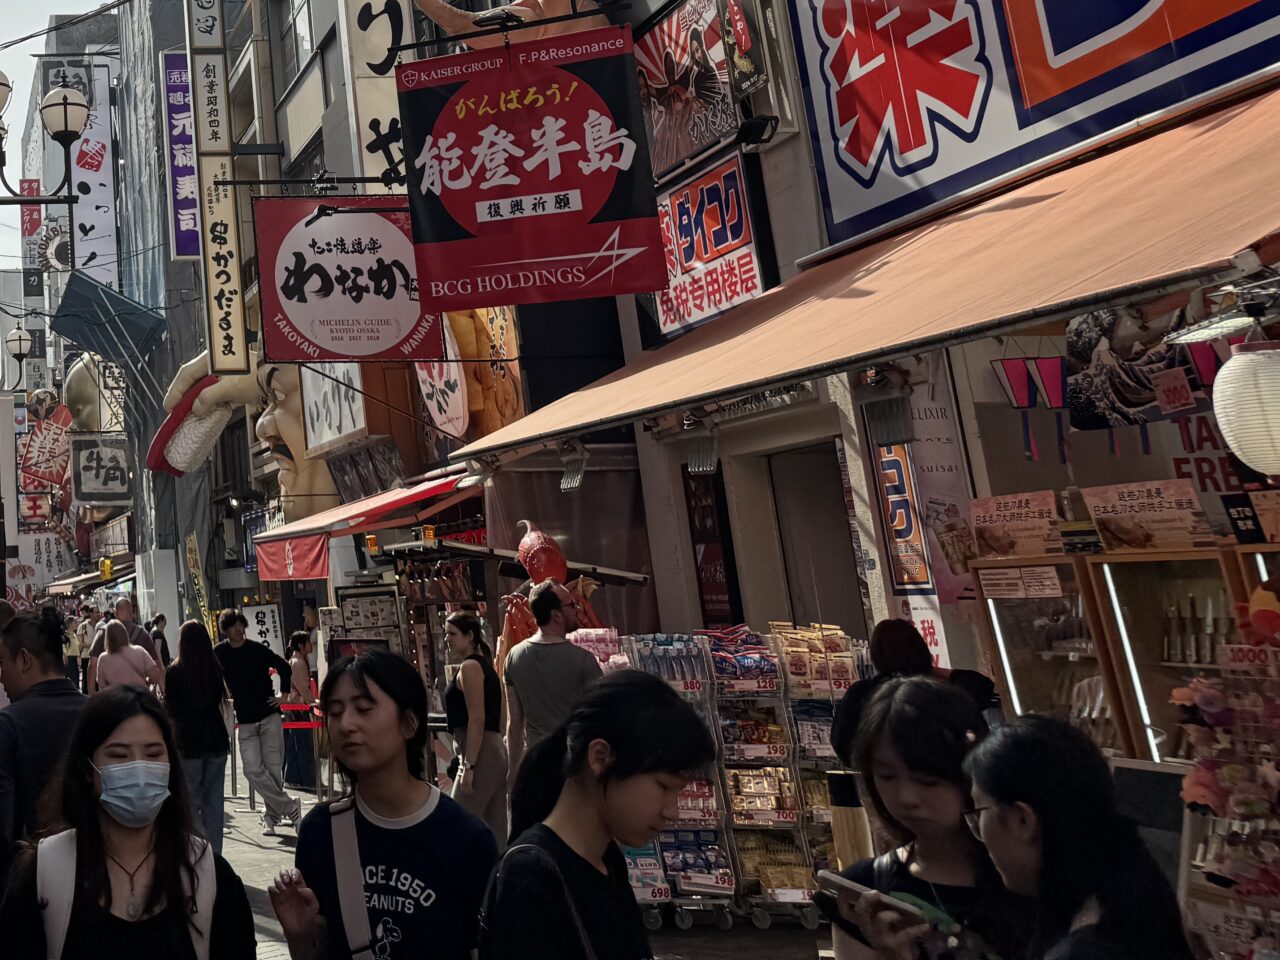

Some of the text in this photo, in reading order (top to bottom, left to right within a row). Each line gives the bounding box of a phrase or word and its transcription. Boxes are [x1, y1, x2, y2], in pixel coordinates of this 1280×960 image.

[420, 58, 504, 81] KAISER GROUP
[518, 38, 625, 65] F.P&Resonance
[203, 64, 222, 143] 創業昭和四年
[455, 81, 579, 120] がんばろう!
[414, 109, 637, 196] 能登半島
[487, 193, 572, 218] 復興祈願
[675, 166, 745, 267] ダイコク
[210, 219, 239, 357] 串かつだるま
[280, 251, 411, 304] わなか
[430, 266, 586, 297] BCG HOLDINGS
[660, 251, 758, 327] 免税专用楼层
[274, 312, 320, 358] TAKOYAKI
[319, 319, 392, 327] MICHELIN GUIDE
[329, 327, 380, 335] KYOTO OSAKA
[399, 313, 436, 356] WANAKA
[1171, 415, 1228, 454] TA
[82, 450, 127, 487] 牛角
[919, 463, 960, 474] suisai
[1172, 455, 1243, 493] FRE
[756, 680, 775, 689] 128
[388, 868, 437, 908] 1950
[651, 888, 670, 898] 698
[714, 876, 734, 887] 198
[363, 892, 415, 914] EANUTS
